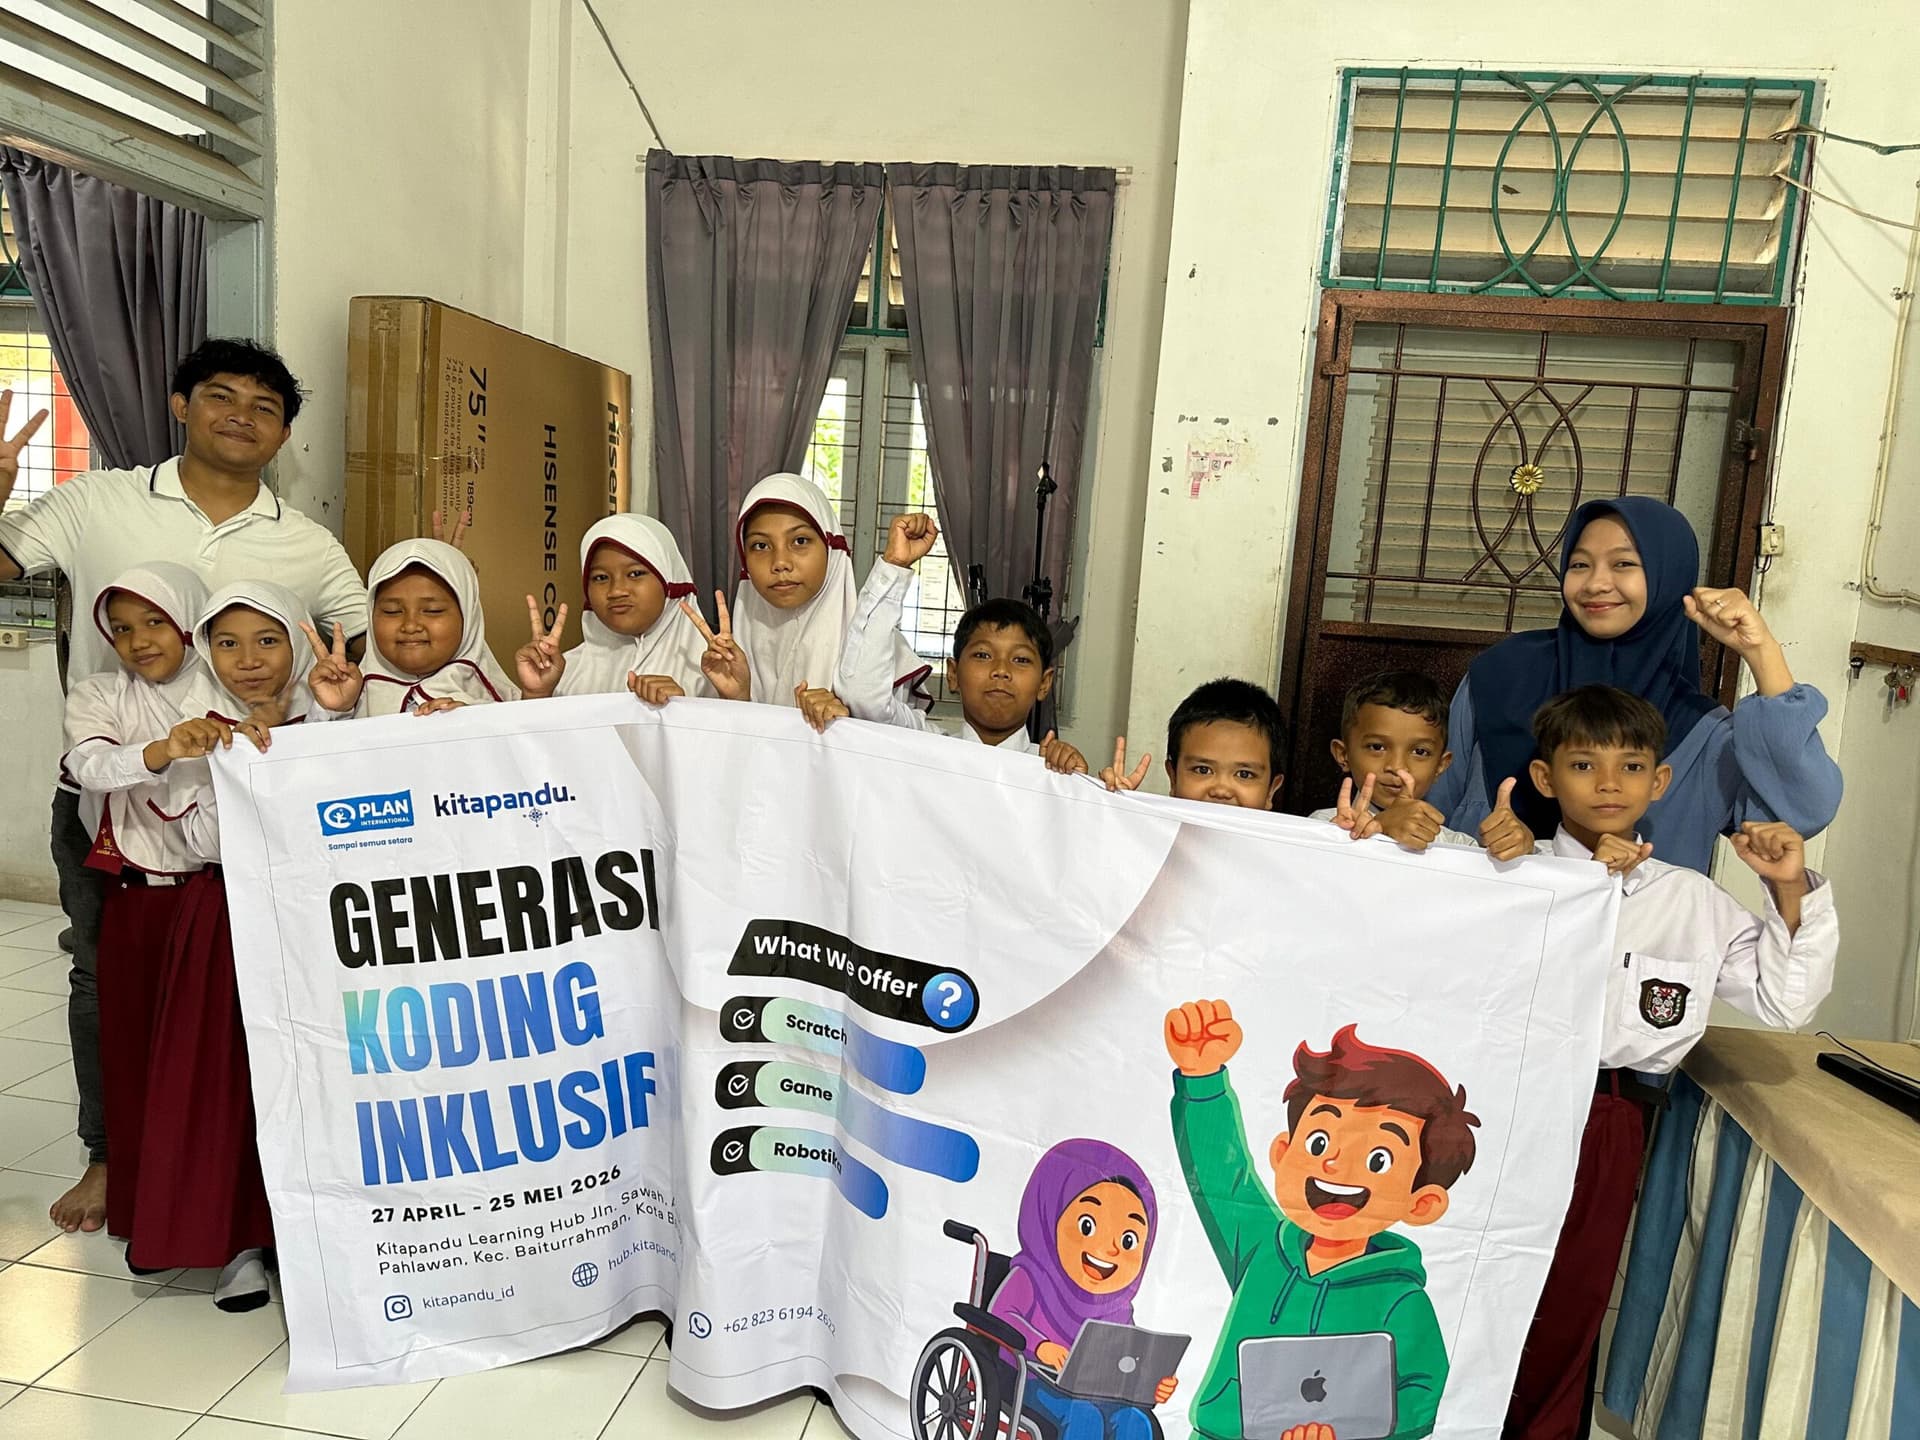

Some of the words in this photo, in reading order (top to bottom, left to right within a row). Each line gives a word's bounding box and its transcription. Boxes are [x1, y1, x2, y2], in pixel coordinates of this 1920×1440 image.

[543, 424, 557, 571] HISENSE
[358, 799, 409, 818] PLAN
[433, 782, 576, 819] kitapandu.
[360, 817, 410, 826] INTERNATIONAL
[328, 841, 358, 851] Sampai
[359, 840, 387, 848] semua
[388, 836, 413, 846] setara
[329, 848, 660, 969] GENERASI
[753, 935, 822, 963] What
[826, 947, 855, 977] We
[857, 966, 918, 999] Offer
[342, 961, 605, 1075] KODING
[786, 1014, 848, 1045] Scratch
[780, 1078, 833, 1101] Game
[355, 1051, 656, 1186] INKLUSIF
[773, 1142, 842, 1175] Robotika
[371, 1208, 395, 1223] 27
[402, 1203, 466, 1222] APRIL
[489, 1194, 516, 1212] 25
[523, 1185, 563, 1205] MEI
[571, 1164, 621, 1194] 2026
[376, 1237, 463, 1257] Kitapandu
[468, 1223, 544, 1245] Learning
[550, 1212, 585, 1233] Hub
[474, 1249, 510, 1264] Kec.
[635, 1202, 664, 1221] Kota
[423, 1285, 515, 1309] kitapandu_id
[723, 1317, 749, 1333] +62
[751, 1309, 775, 1327] 823
[779, 1306, 814, 1320] 6194
